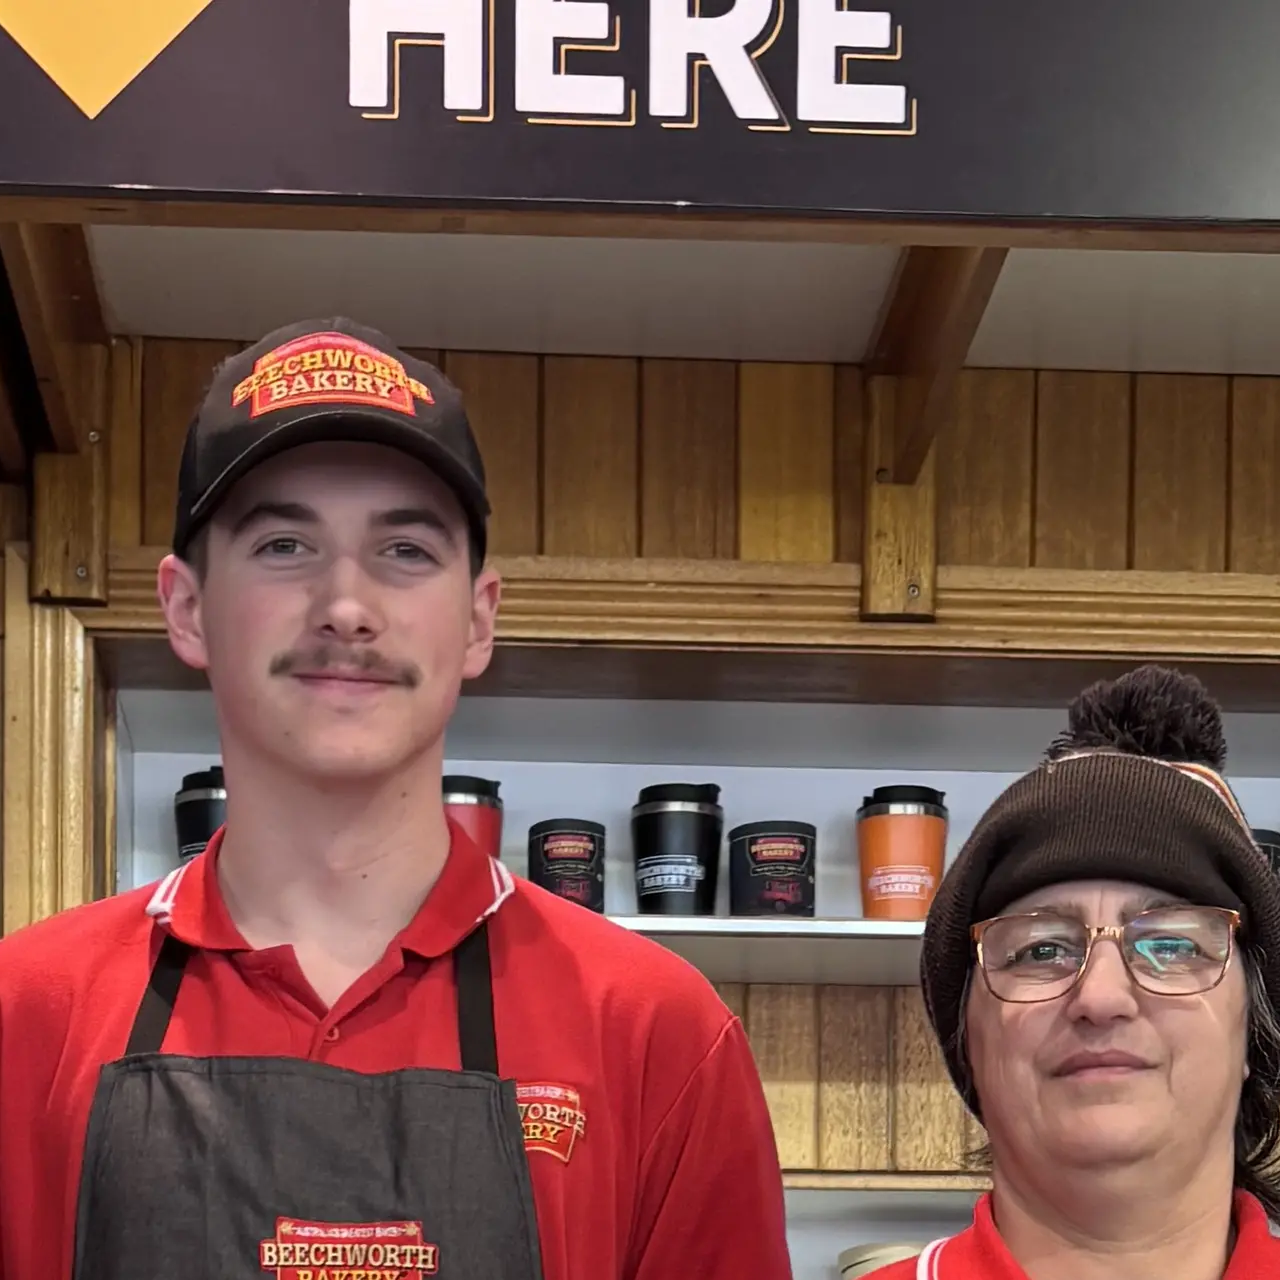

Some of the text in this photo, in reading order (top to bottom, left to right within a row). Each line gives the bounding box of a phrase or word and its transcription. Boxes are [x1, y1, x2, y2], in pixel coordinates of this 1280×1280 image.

[349, 0, 912, 130] HERE
[271, 369, 396, 401] BAKERY
[262, 1243, 436, 1269] BEECHWORTH
